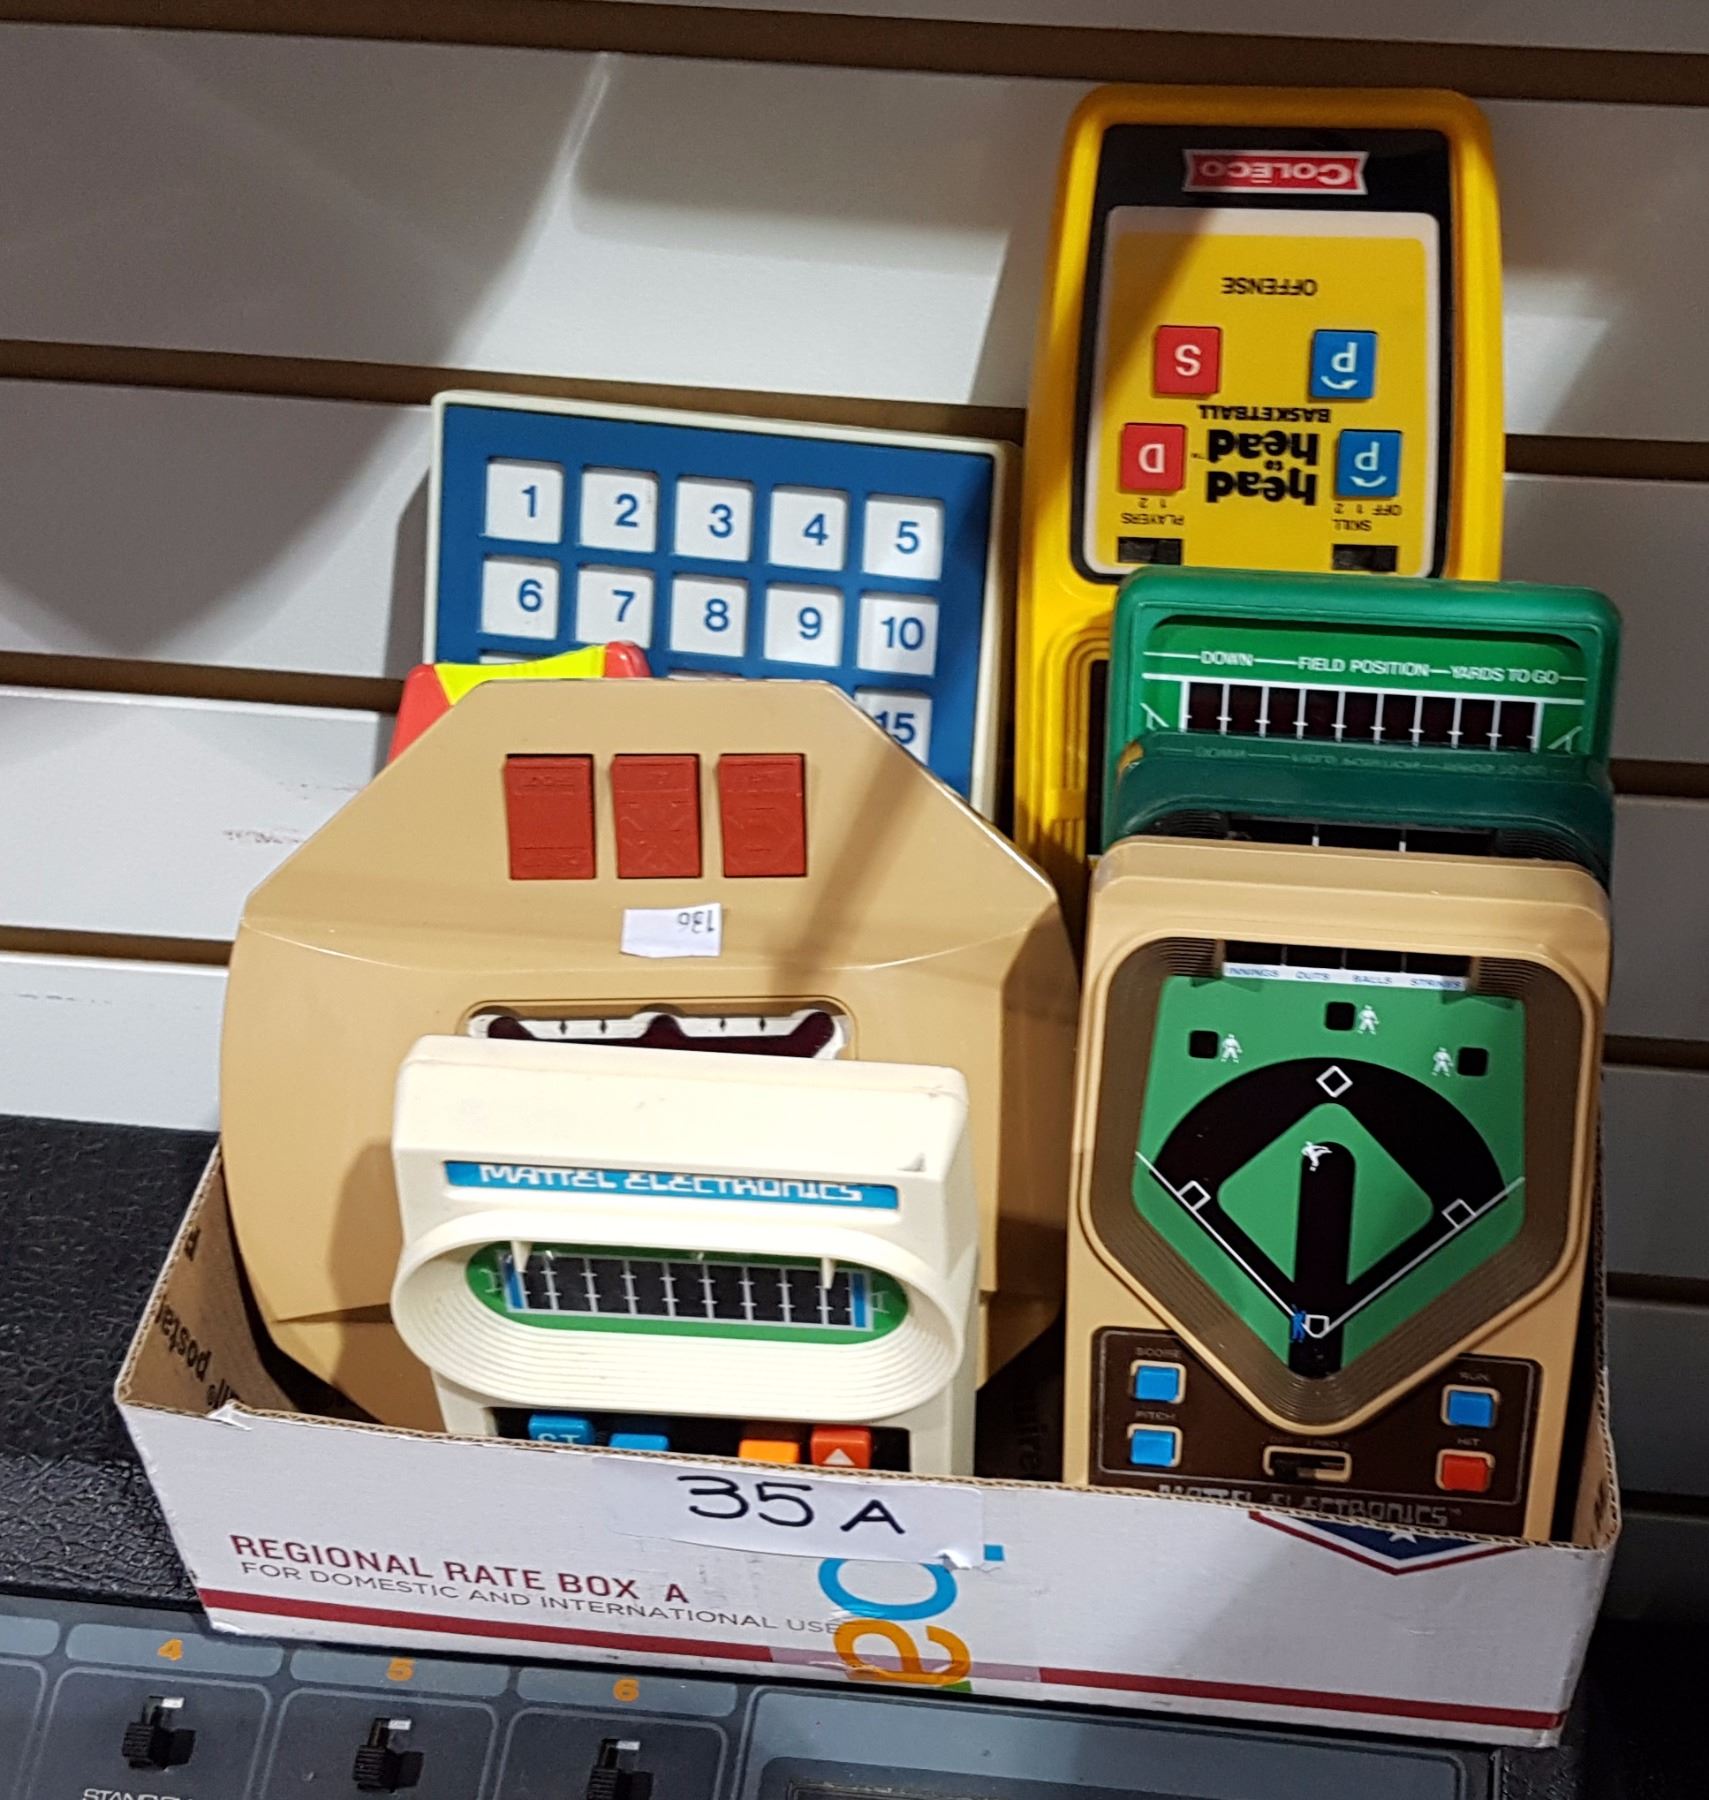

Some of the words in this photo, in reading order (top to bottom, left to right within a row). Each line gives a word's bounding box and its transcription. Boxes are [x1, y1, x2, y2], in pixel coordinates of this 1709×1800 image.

[1201, 158, 1353, 187] COLECO
[1221, 276, 1319, 297] OFFENSE
[1173, 343, 1202, 377] S
[1331, 341, 1358, 374] P
[1197, 404, 1332, 423] BASKETBALL
[1137, 442, 1166, 474] D
[1206, 428, 1319, 466] head
[1353, 440, 1380, 473] P
[1206, 470, 1319, 506] head
[521, 484, 539, 518] 1
[614, 492, 640, 528] 2
[708, 503, 734, 539] 3
[802, 512, 829, 547] 4
[895, 521, 920, 555] 5
[1120, 511, 1185, 527] PLAYERS
[1332, 518, 1373, 532] SKILL
[1371, 503, 1403, 516] OFF
[518, 578, 543, 613] 6
[612, 589, 635, 623] 7
[704, 597, 730, 633] 8
[797, 606, 823, 641] 9
[880, 615, 925, 652] 10
[1200, 650, 1254, 668] DOWN
[1297, 655, 1346, 674] FIELD
[1349, 659, 1430, 678] POSITION
[1450, 665, 1505, 682] YARDS
[1507, 668, 1530, 683] TO
[1531, 669, 1560, 685] GO
[874, 710, 917, 745] 15
[1352, 973, 1393, 985] BALLS
[479, 1164, 618, 1190] MATTEL
[624, 1173, 863, 1203] ELECTRONICS
[677, 1474, 814, 1528] 35
[840, 1497, 906, 1535] A
[229, 1533, 433, 1579] REGIONAL
[443, 1560, 546, 1591] RATE
[557, 1571, 641, 1601] BOX
[664, 1582, 690, 1604] A
[240, 1560, 302, 1581] FOR
[308, 1569, 460, 1599] DOMESTIC
[468, 1589, 531, 1607] AND
[540, 1595, 778, 1630] INTERNATIONAL
[786, 1617, 842, 1636] USE
[157, 1638, 184, 1662] 4
[386, 1657, 414, 1681] 5
[612, 1678, 640, 1702] 6
